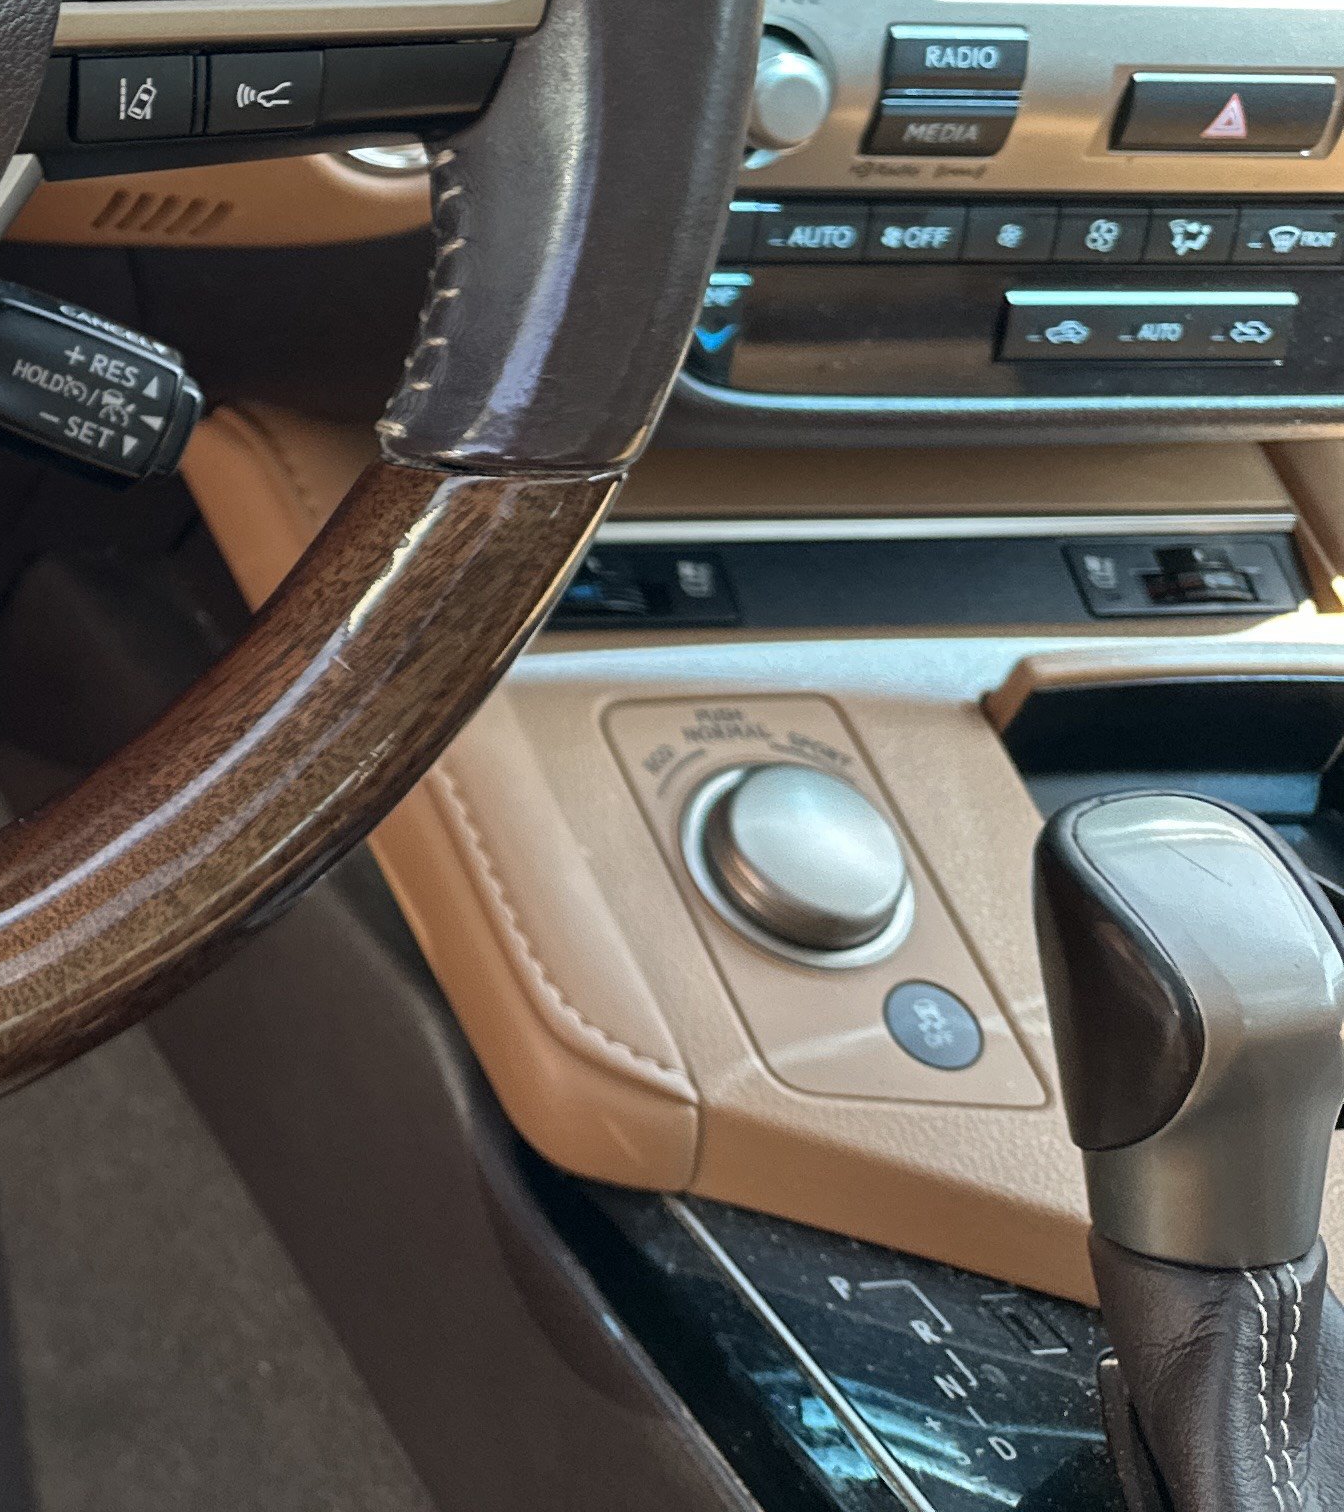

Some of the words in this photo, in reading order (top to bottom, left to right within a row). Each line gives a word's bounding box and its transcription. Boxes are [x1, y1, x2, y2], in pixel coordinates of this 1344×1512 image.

[924, 45, 1000, 69] RADIO
[903, 123, 980, 144] MEDIA
[788, 225, 857, 249] AUTO
[903, 226, 952, 249] OFF
[59, 305, 155, 352] CANCEL
[1137, 323, 1184, 341] AUTO
[12, 359, 65, 392] HOLD
[88, 353, 140, 388] RES
[64, 416, 116, 449] SET
[827, 1275, 852, 1301] P
[910, 1319, 943, 1345] R
[933, 1373, 968, 1399] N
[988, 1436, 1017, 1461] D
